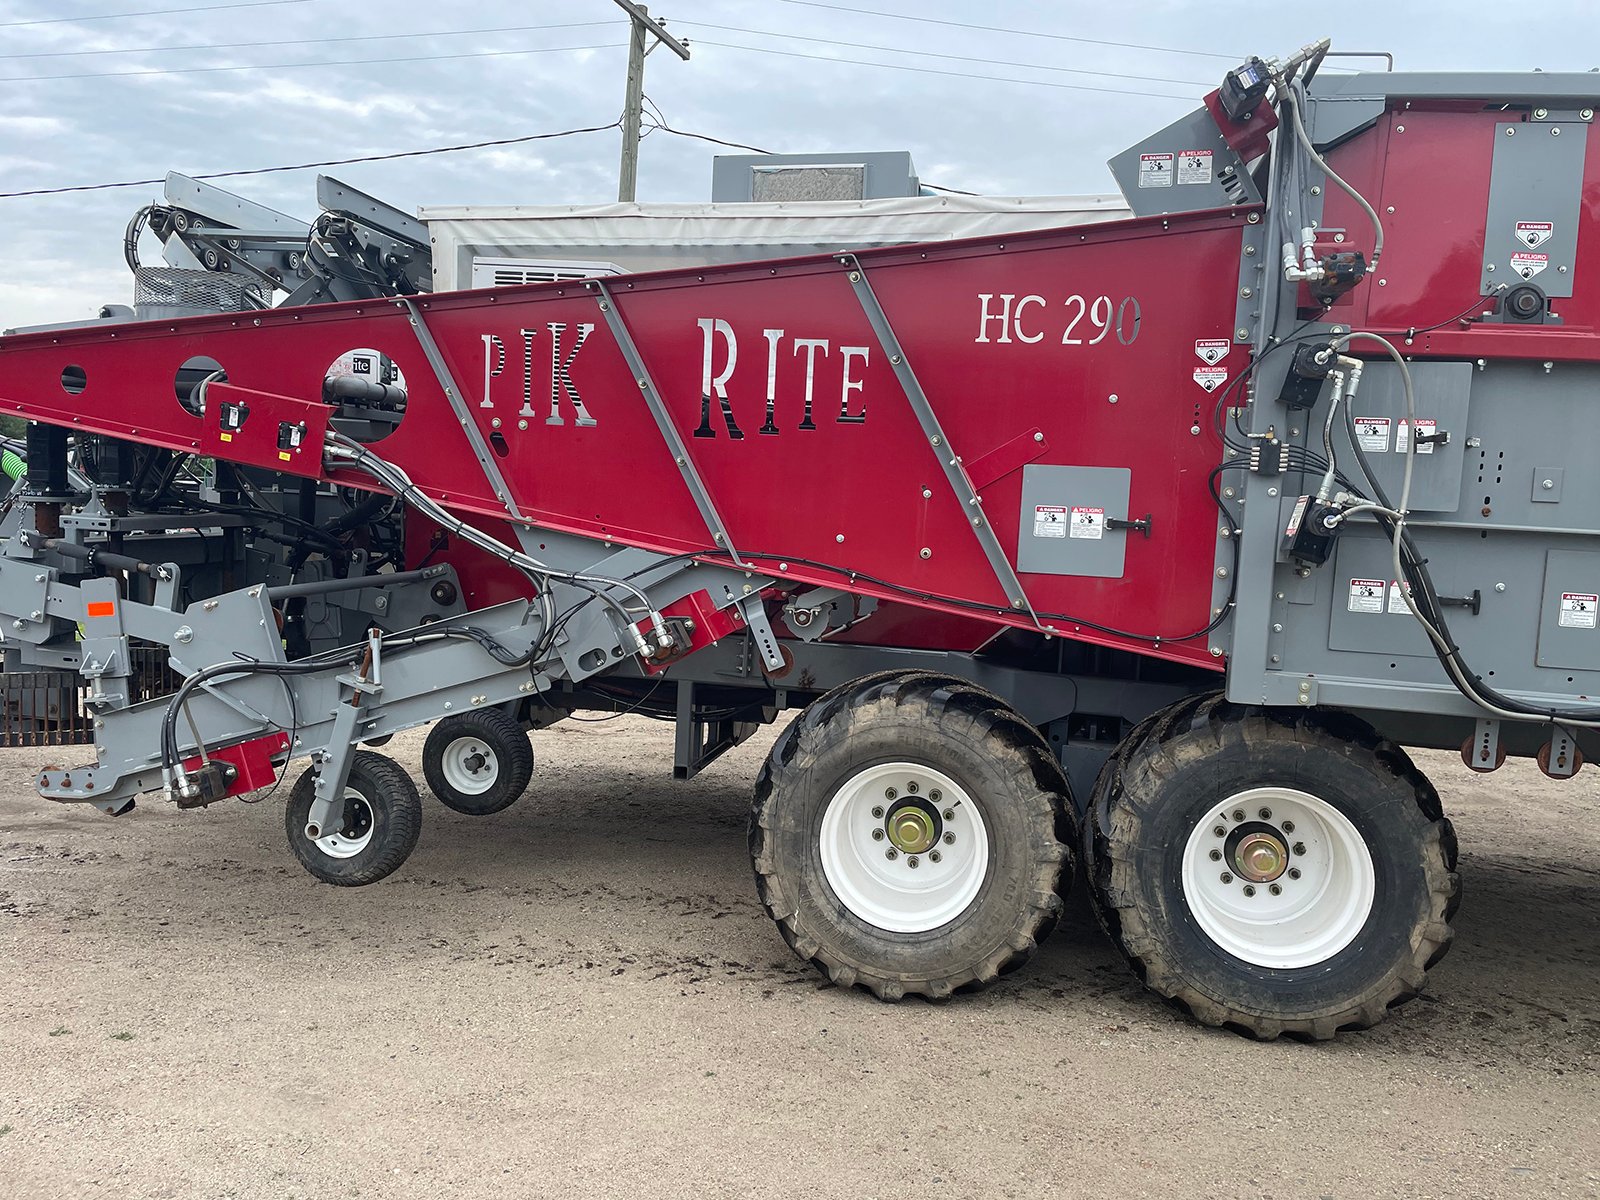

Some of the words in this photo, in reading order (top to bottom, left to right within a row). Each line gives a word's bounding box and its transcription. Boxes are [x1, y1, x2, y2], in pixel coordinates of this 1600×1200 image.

[975, 293, 1046, 344] HC
[1062, 294, 1141, 345] 290
[354, 358, 370, 371] ite
[480, 322, 598, 427] PIK
[693, 318, 870, 441] RITE
